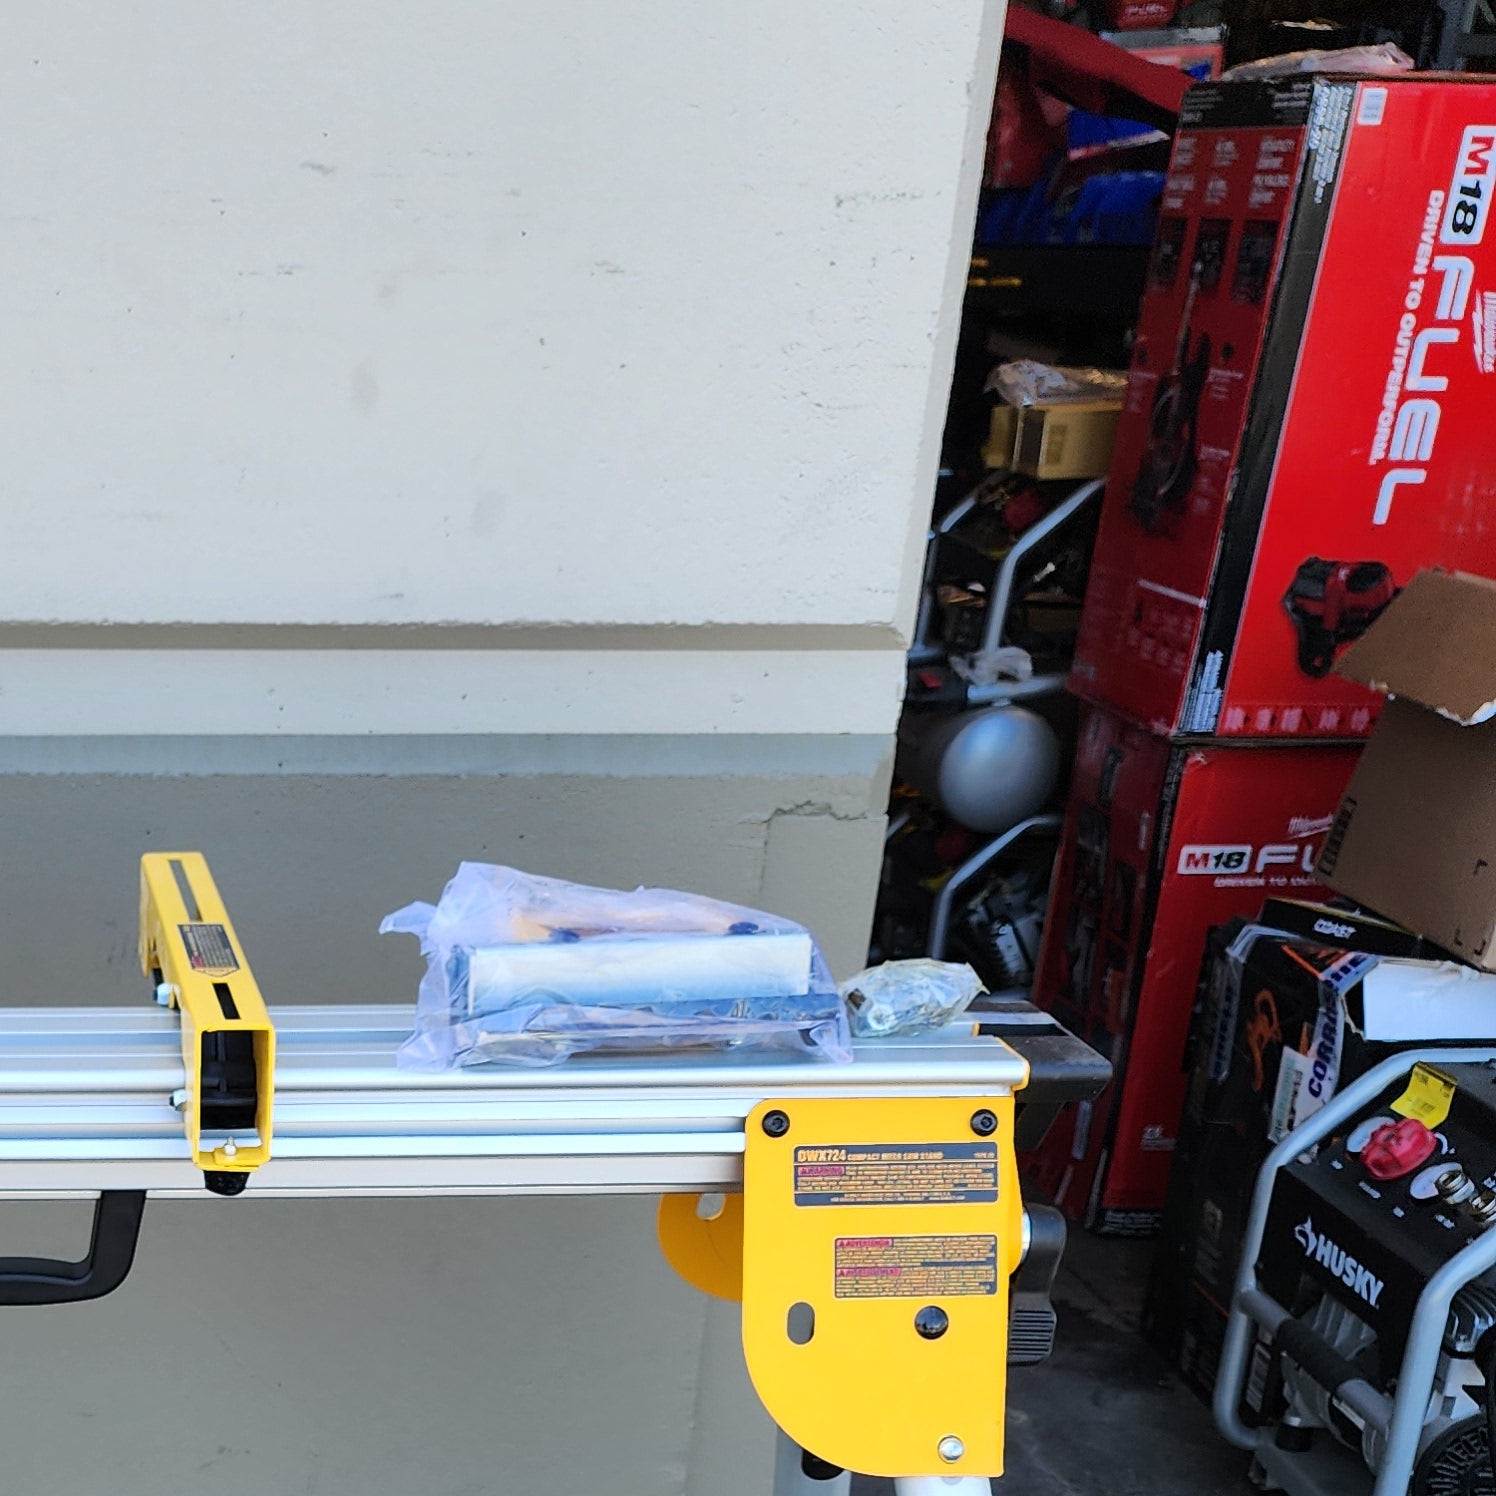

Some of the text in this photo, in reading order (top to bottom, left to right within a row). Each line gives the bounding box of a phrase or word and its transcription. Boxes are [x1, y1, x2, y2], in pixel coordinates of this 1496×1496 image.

[1451, 135, 1495, 235] M18
[1413, 190, 1445, 274] DRIVEN
[1404, 277, 1425, 310] TO
[1372, 255, 1475, 525] FUEL
[1185, 851, 1247, 870] M18
[797, 1149, 846, 1162] DWX724
[1315, 1233, 1384, 1307] HUSKY
